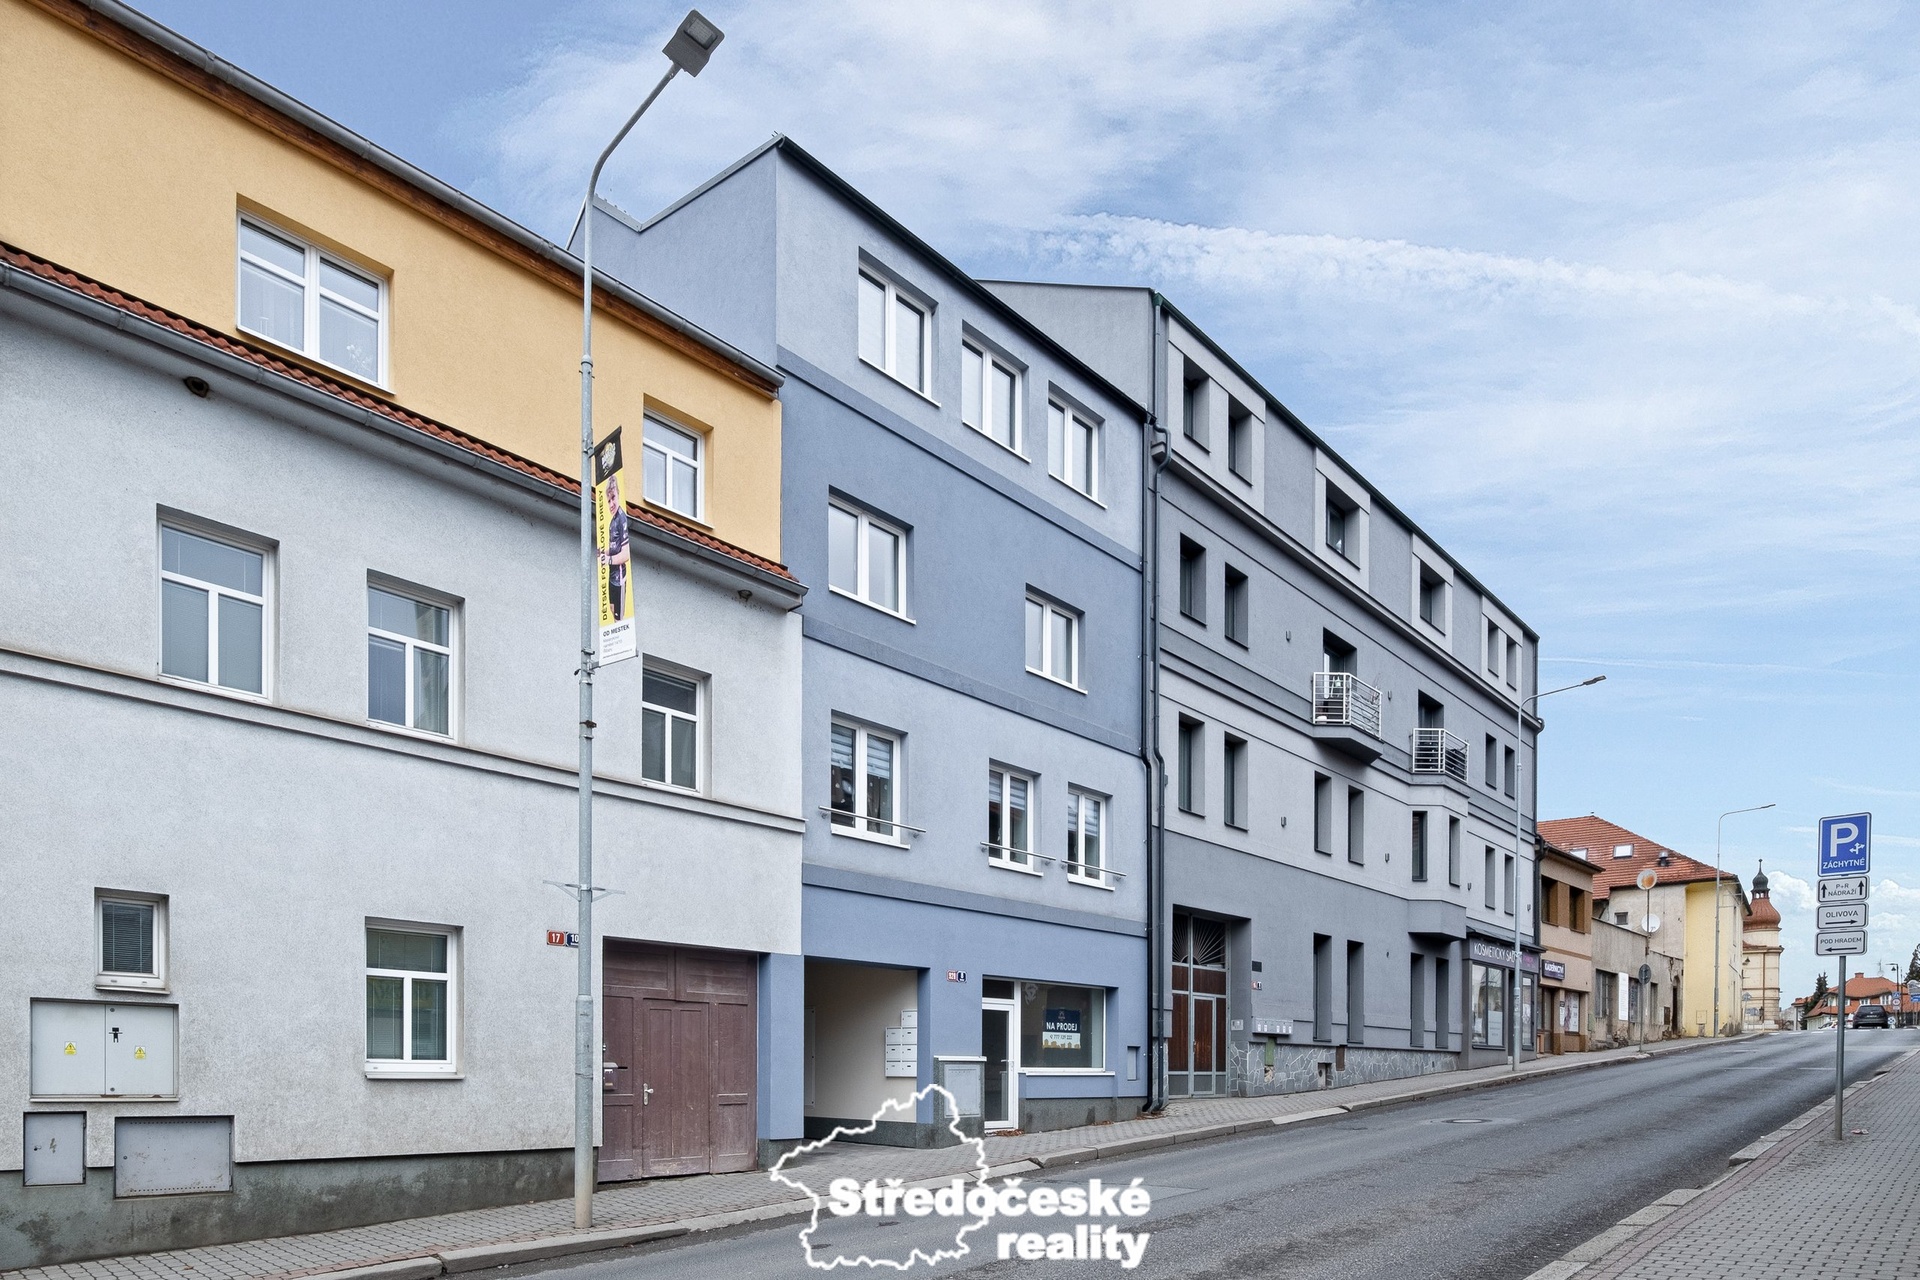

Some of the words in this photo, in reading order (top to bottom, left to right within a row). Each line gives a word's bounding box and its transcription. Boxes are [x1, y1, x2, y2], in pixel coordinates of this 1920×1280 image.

[1830, 822, 1859, 857] P
[1822, 857, 1865, 869] ZÁCHYTNÉ
[1828, 888, 1857, 896] NÁDRAŽÍ
[1825, 910, 1858, 918] OLIVOVA
[551, 933, 561, 943] 17
[1046, 1021, 1055, 1030] NA
[1056, 1022, 1077, 1031] PRODEJ
